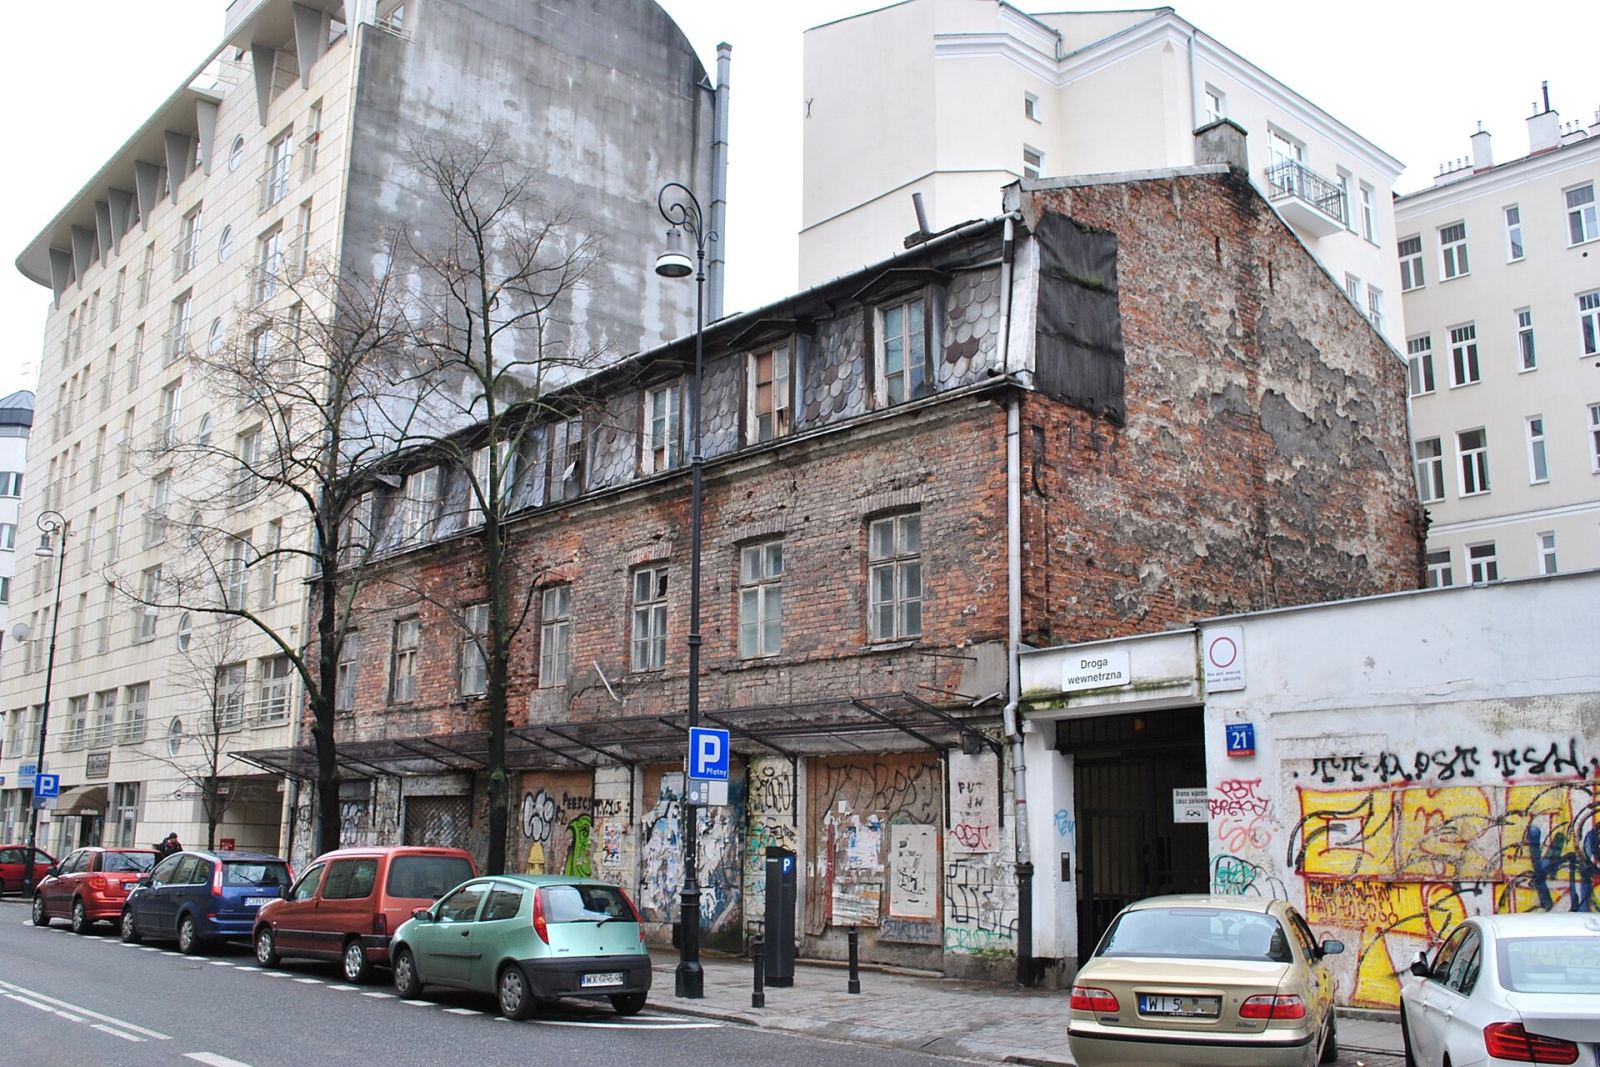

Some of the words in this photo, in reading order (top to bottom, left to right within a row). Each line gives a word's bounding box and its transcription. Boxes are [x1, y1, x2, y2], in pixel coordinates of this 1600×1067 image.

[1081, 658, 1108, 670] Droga
[1232, 731, 1247, 749] 21
[698, 734, 720, 773] P
[39, 776, 55, 795] P
[783, 858, 791, 871] P
